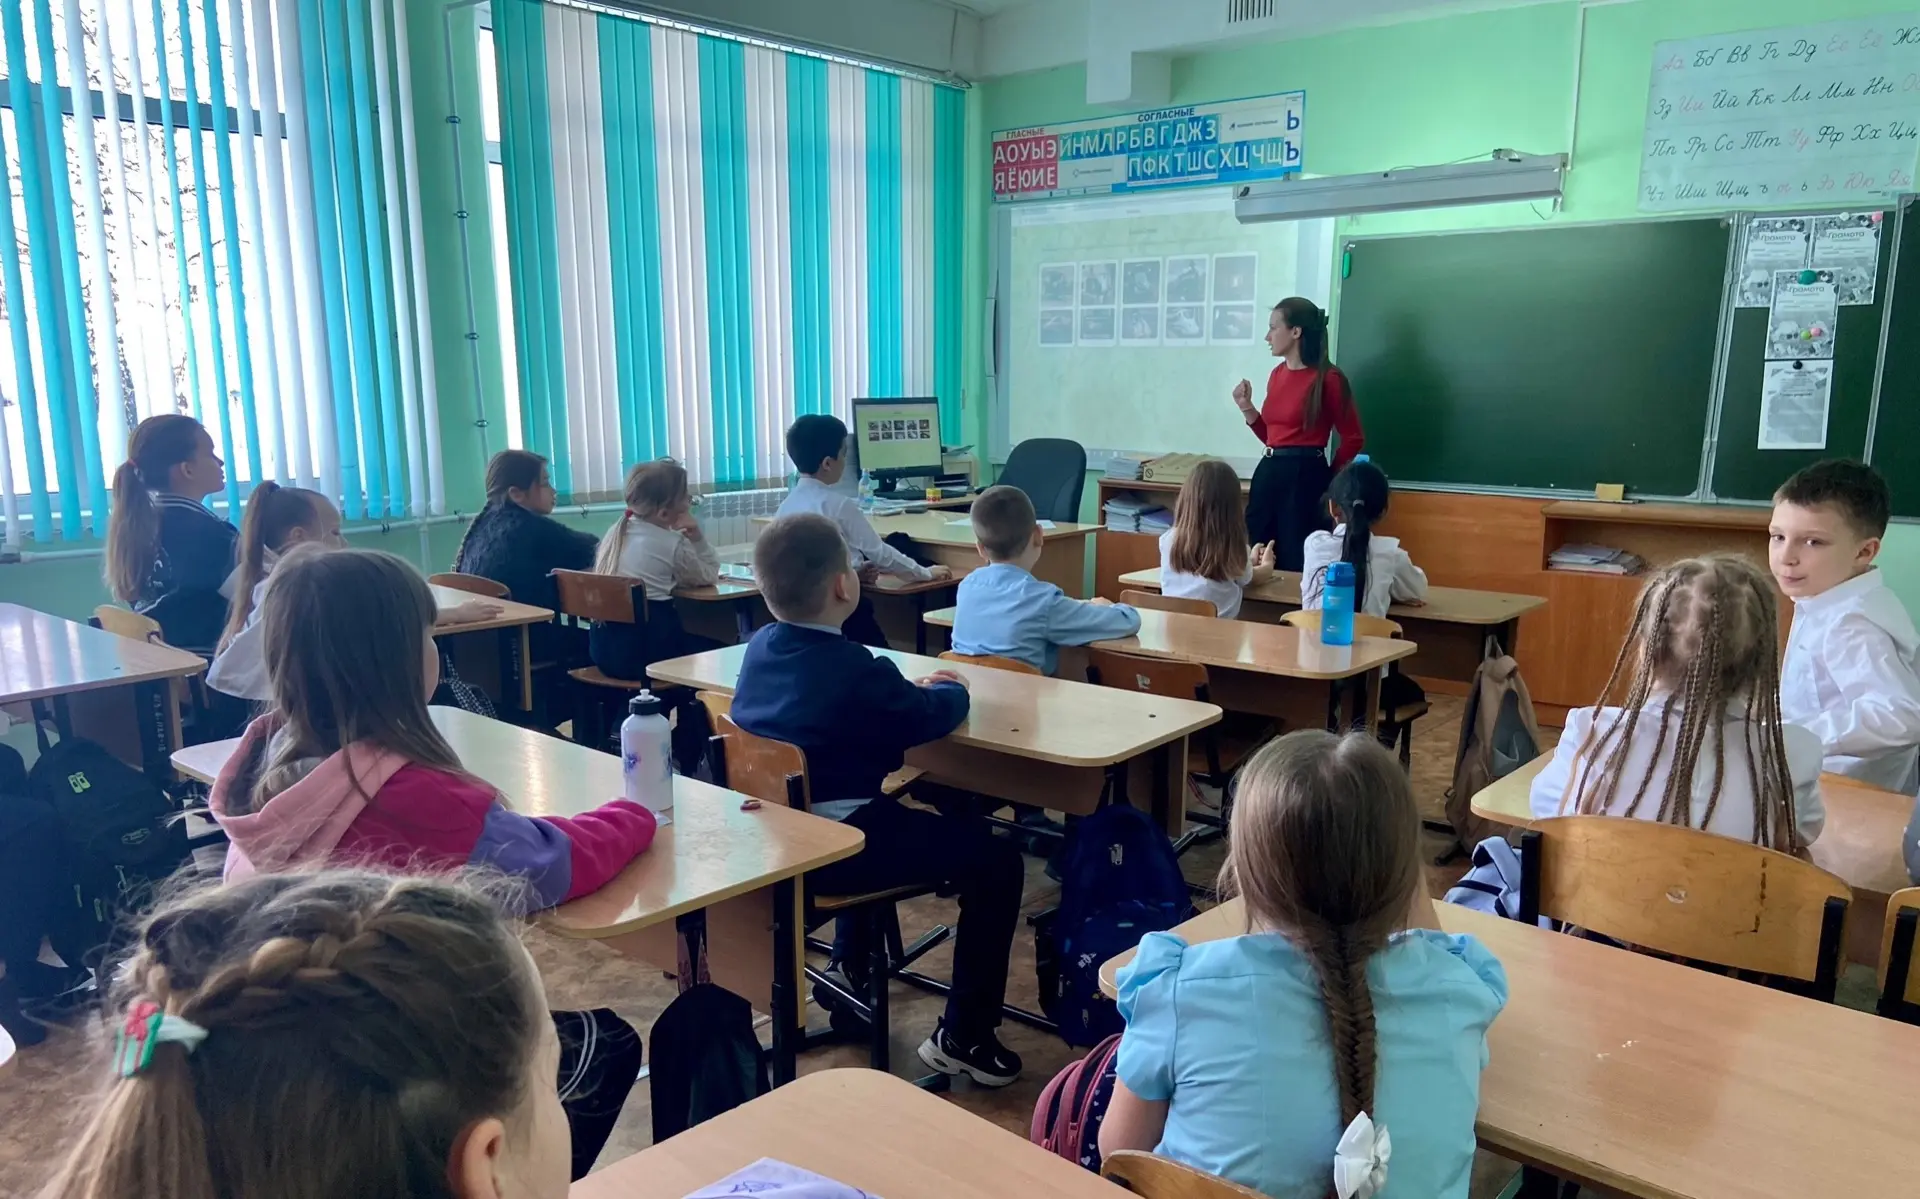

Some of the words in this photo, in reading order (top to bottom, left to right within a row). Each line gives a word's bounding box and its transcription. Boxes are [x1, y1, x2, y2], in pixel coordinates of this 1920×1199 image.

[1693, 48, 1723, 67] Бб
[1726, 44, 1752, 64] Вв
[1758, 41, 1779, 60] Гг
[1788, 39, 1818, 63] Дд
[1653, 98, 1672, 120] Зз
[1712, 89, 1740, 109] Йй
[1746, 88, 1776, 107] Кк
[1781, 83, 1812, 103] Лл
[1818, 81, 1857, 100] Мм
[1862, 76, 1894, 95] Нн
[1137, 107, 1196, 123] СОГЛАСНЫЕ
[1006, 127, 1045, 140] ГЛАСНЫЕ
[1649, 138, 1677, 157] Пп
[1684, 136, 1708, 160] Рр
[1714, 133, 1735, 152] Сс
[1740, 130, 1781, 150] Тт
[1815, 125, 1845, 150] Фф
[1851, 123, 1882, 141] Хх
[1888, 121, 1918, 140] Цц
[1645, 184, 1666, 202] Чч
[1674, 182, 1708, 200] Шш
[1715, 179, 1750, 199] Щщ
